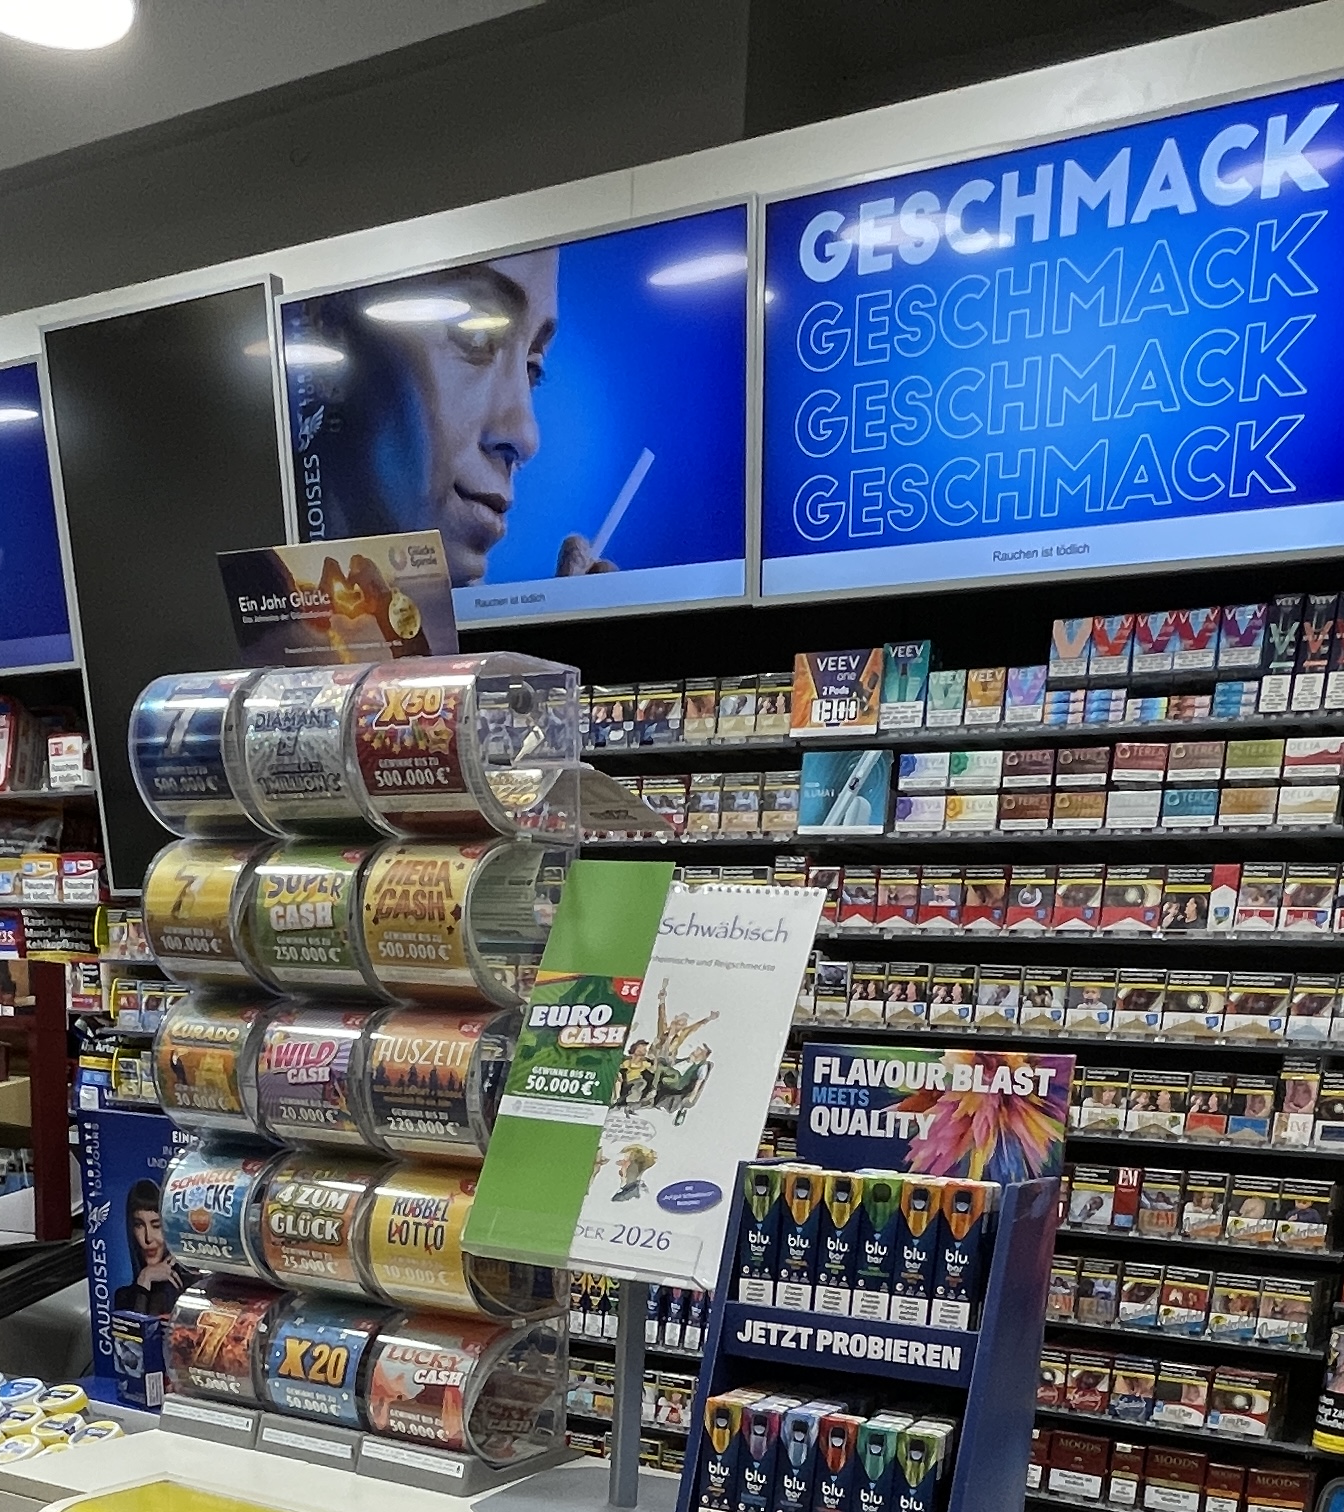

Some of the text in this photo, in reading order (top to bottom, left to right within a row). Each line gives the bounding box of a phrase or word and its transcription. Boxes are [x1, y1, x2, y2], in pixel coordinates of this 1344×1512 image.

[799, 103, 1340, 283] GESCHMACK
[795, 210, 1328, 372] GESCHMACK
[794, 314, 1316, 458] GESCHMACK
[793, 414, 1305, 541] GESCHMACK
[992, 541, 1090, 564] Rauchen ist tödlich
[239, 596, 287, 613] Ein Jahr
[889, 645, 923, 658] VEEV
[817, 656, 860, 671] VEEV
[837, 672, 856, 681] one
[970, 670, 1005, 682] VEEV
[255, 709, 336, 728] DIAMANT
[372, 687, 443, 729] X50
[375, 769, 435, 788] 500.000
[267, 872, 344, 899] SUPER
[375, 858, 453, 896] MEGA
[374, 889, 447, 921] CASH
[269, 902, 334, 932] CASH
[657, 912, 789, 944] Schwäbisch
[529, 1004, 614, 1028] EURO
[558, 1026, 626, 1048] CASH
[274, 1040, 338, 1068] WILD
[378, 1038, 471, 1068] AUSZEIT
[287, 1066, 332, 1085] CASH
[813, 1055, 1056, 1097] FLAVOUR BLAST
[811, 1085, 870, 1107] MEETS
[809, 1108, 937, 1141] QUALITY
[170, 1169, 240, 1192] SCHNELLE
[277, 1186, 350, 1210] 4 ZUM
[392, 1197, 451, 1222] RUBBEL
[270, 1210, 343, 1242] GLÜCK
[387, 1218, 446, 1252] LOTTO
[610, 1224, 672, 1251] 2026
[748, 1231, 770, 1244] blu
[788, 1234, 809, 1248] blu
[827, 1238, 849, 1251] blu
[865, 1240, 888, 1255] blu
[903, 1246, 926, 1261] blu
[945, 1249, 969, 1265] blu
[91, 1238, 113, 1356] GAULOISES
[737, 1319, 961, 1371] JETZT PROBIEREN
[386, 1346, 464, 1370] LUCKY
[414, 1369, 464, 1386] CASH
[708, 1461, 729, 1477] blu
[745, 1468, 767, 1484] blu
[783, 1475, 806, 1491] blu
[822, 1482, 844, 1498] blu
[860, 1489, 883, 1505] blu
[899, 1496, 924, 1512] blu
